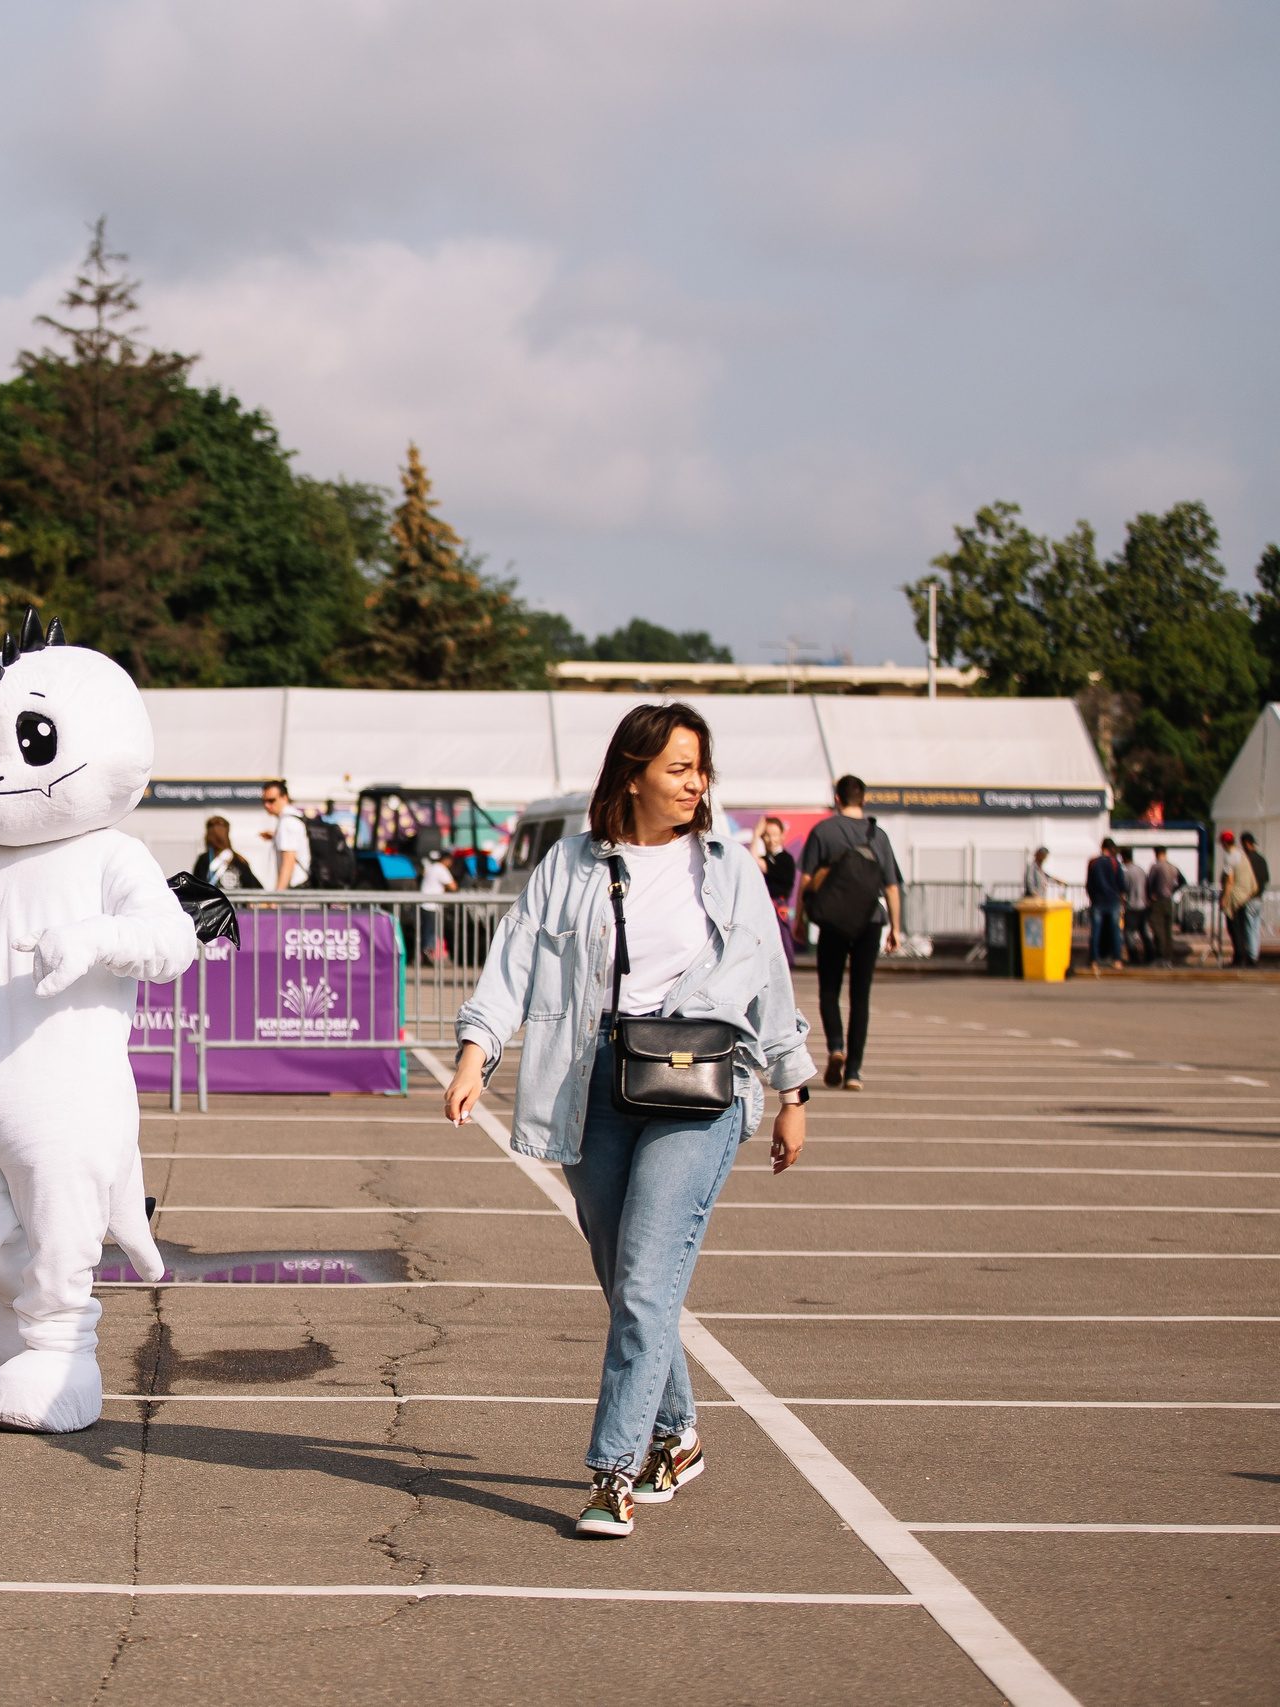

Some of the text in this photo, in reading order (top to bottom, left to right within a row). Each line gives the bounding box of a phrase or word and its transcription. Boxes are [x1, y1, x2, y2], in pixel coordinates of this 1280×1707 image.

[984, 789, 1033, 809] Changing
[1034, 794, 1061, 807] room
[1062, 794, 1102, 808] women
[285, 928, 361, 945] CROCUS
[285, 945, 361, 961] FITNESS
